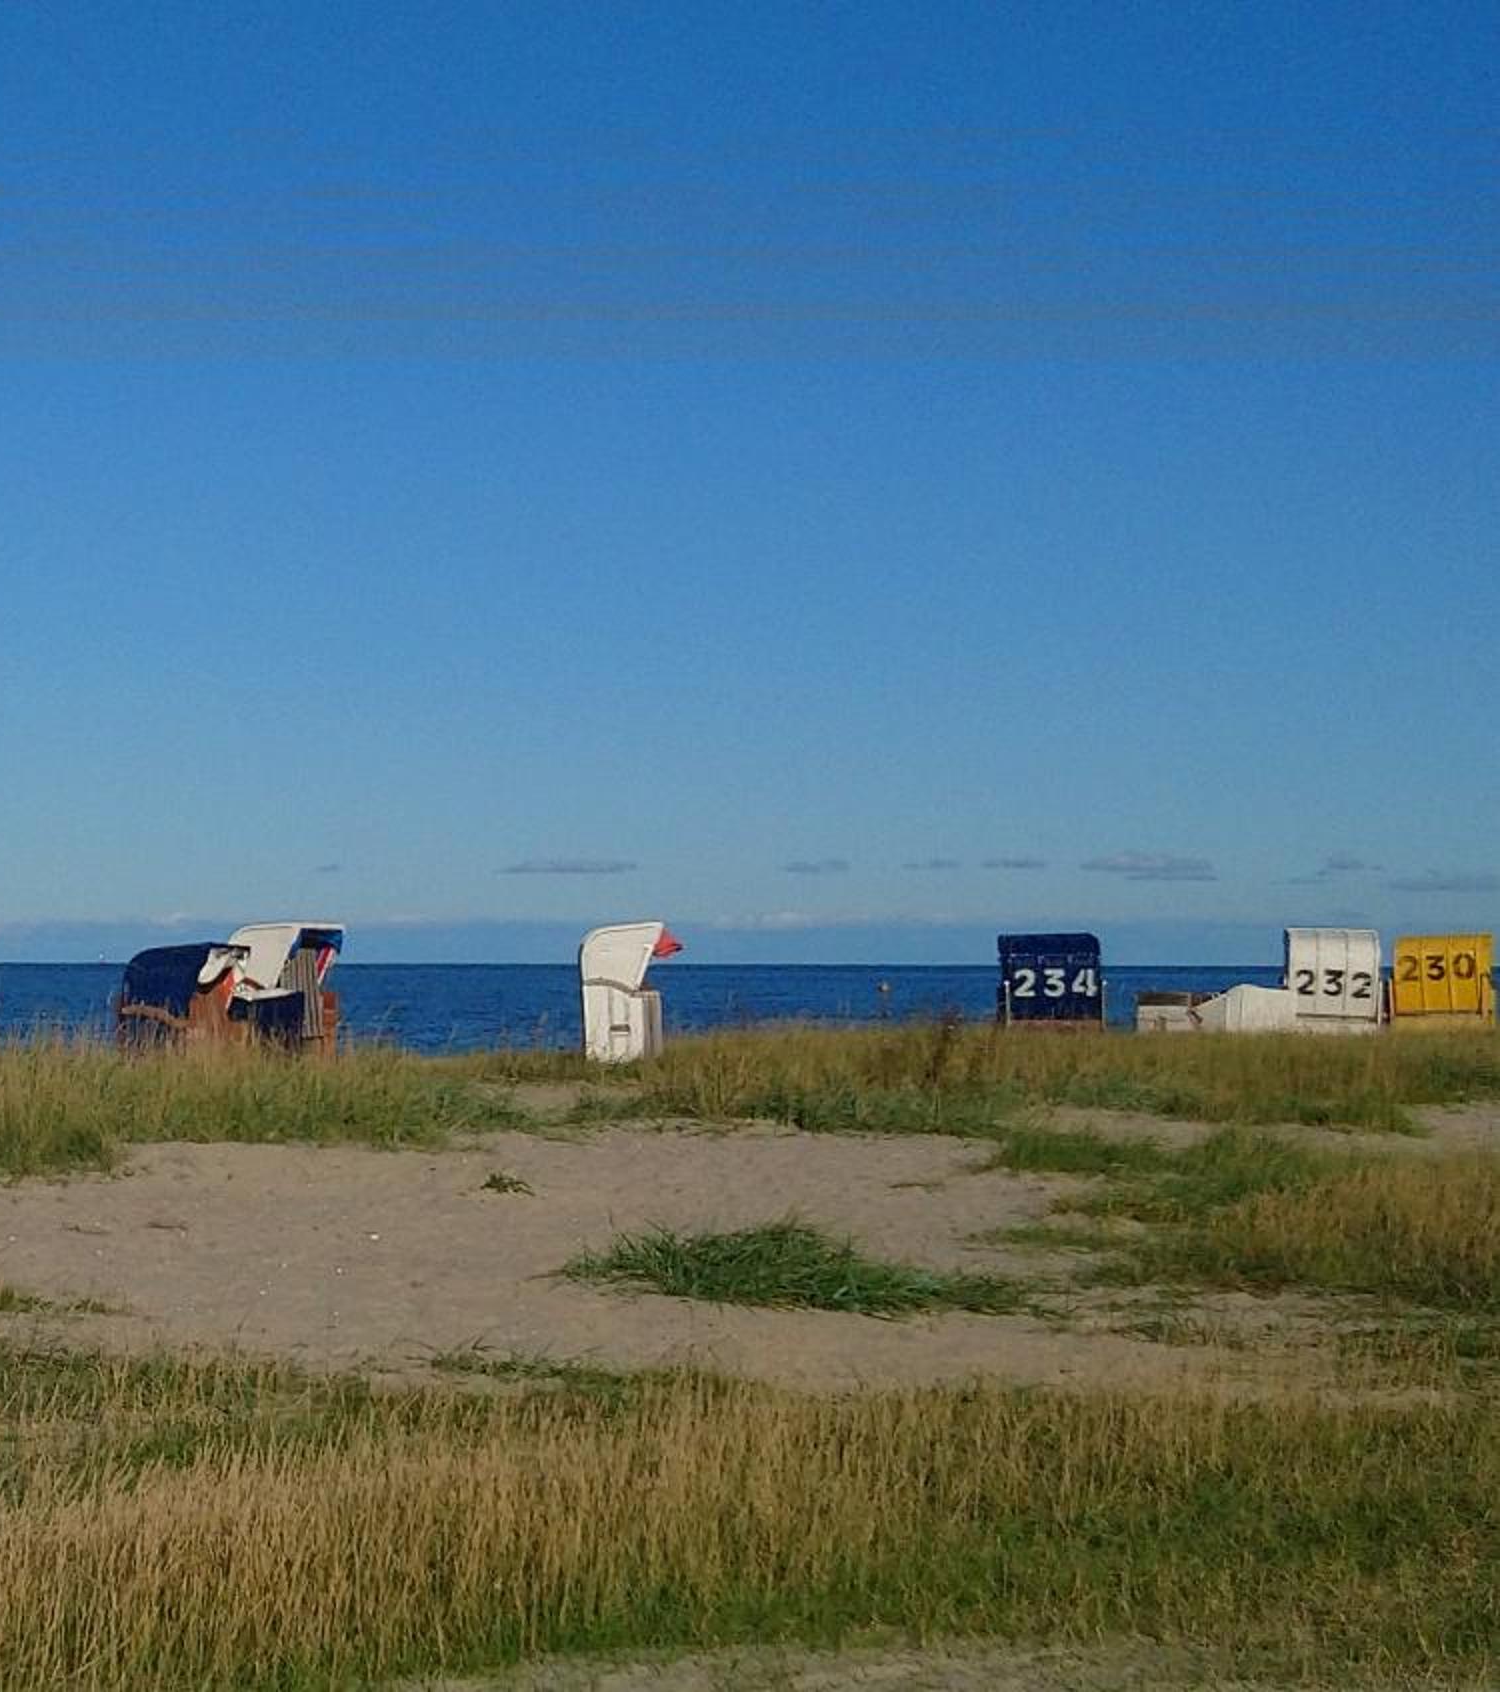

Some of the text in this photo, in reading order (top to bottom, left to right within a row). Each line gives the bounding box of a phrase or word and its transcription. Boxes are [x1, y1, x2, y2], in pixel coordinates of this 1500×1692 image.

[1399, 953, 1476, 981] 230
[1014, 968, 1098, 997] 234
[1296, 970, 1372, 998] 232
